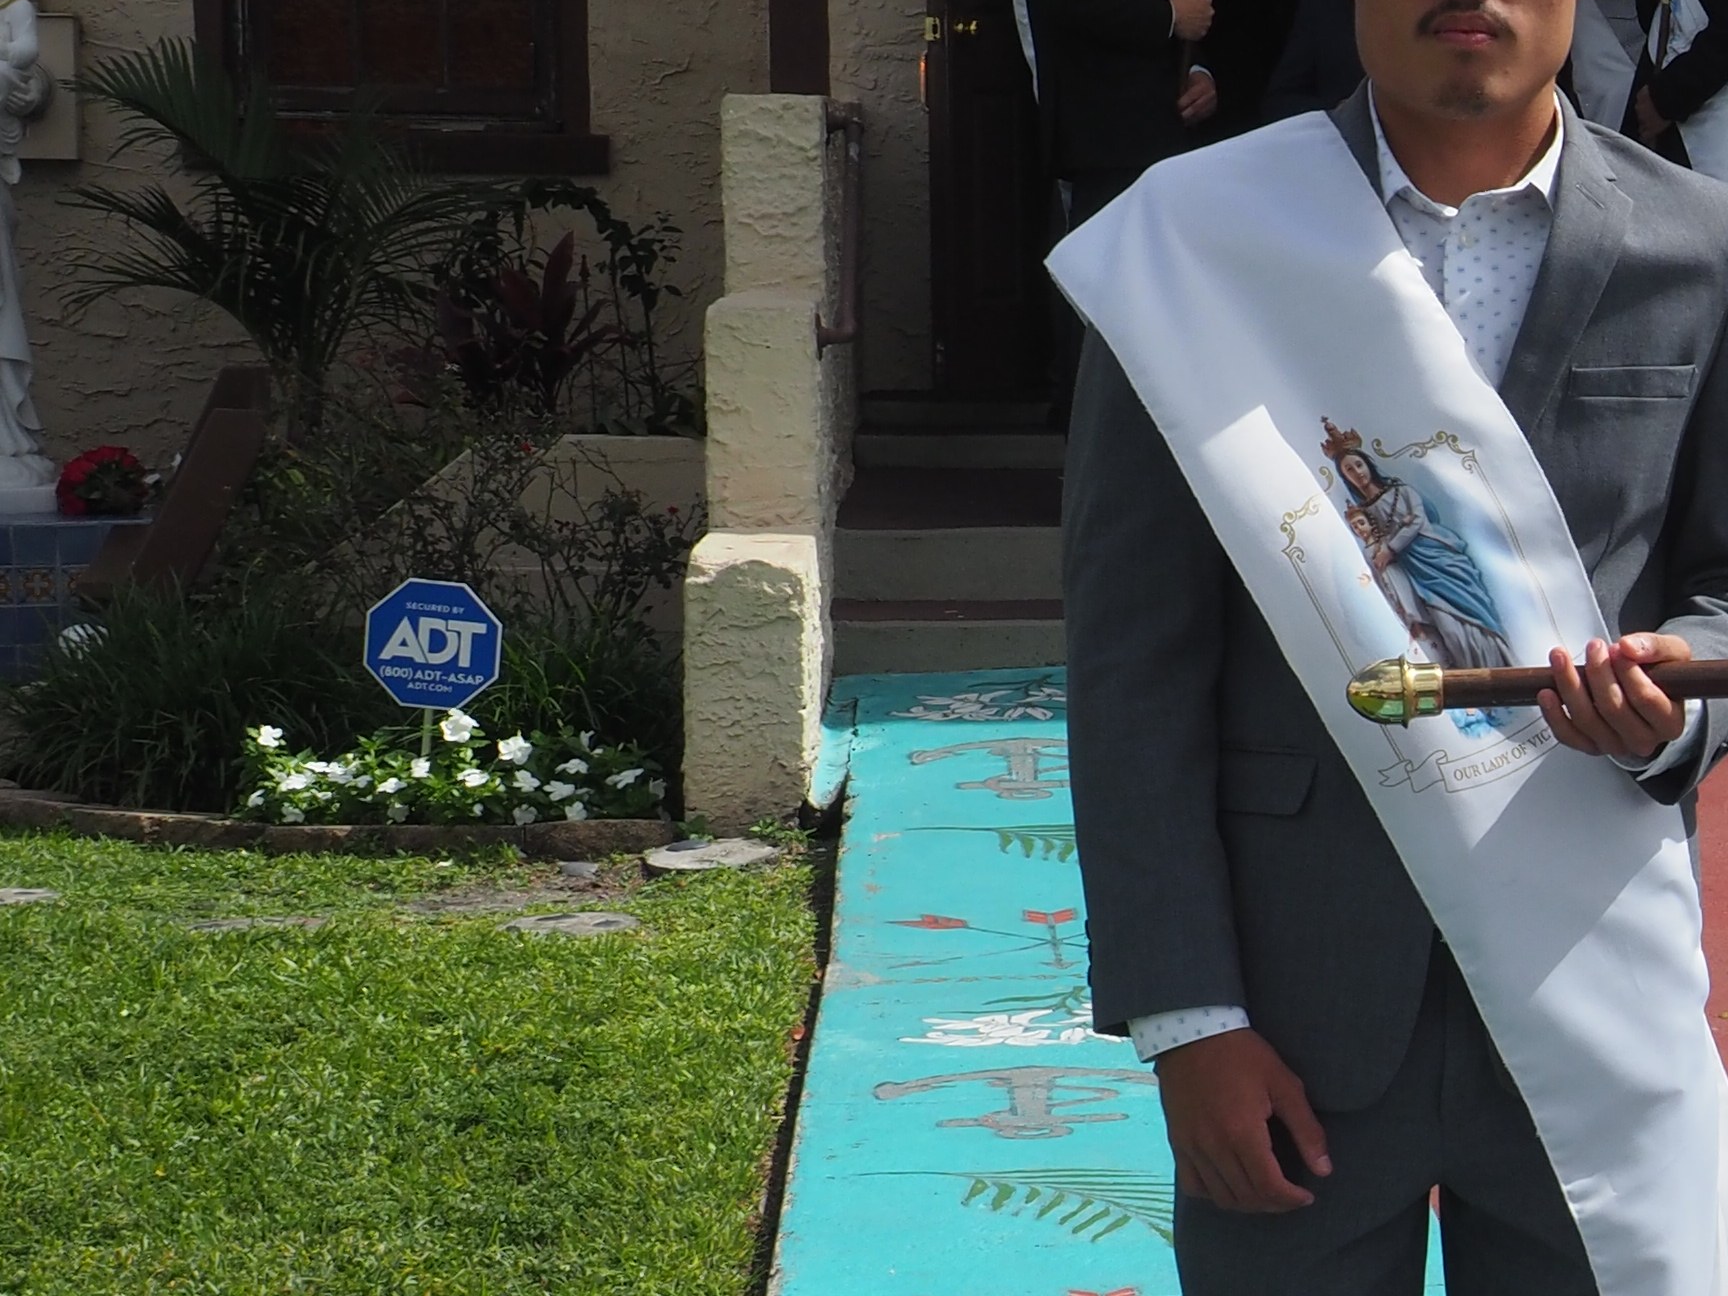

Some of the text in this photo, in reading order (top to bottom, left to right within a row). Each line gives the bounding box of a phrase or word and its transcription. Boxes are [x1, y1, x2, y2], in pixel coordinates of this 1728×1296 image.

[406, 602, 465, 614] SECURED BY
[377, 615, 488, 668] ADT
[380, 665, 484, 685] (800) ADT-ASAP
[1453, 742, 1528, 782] OUR LADY OF
